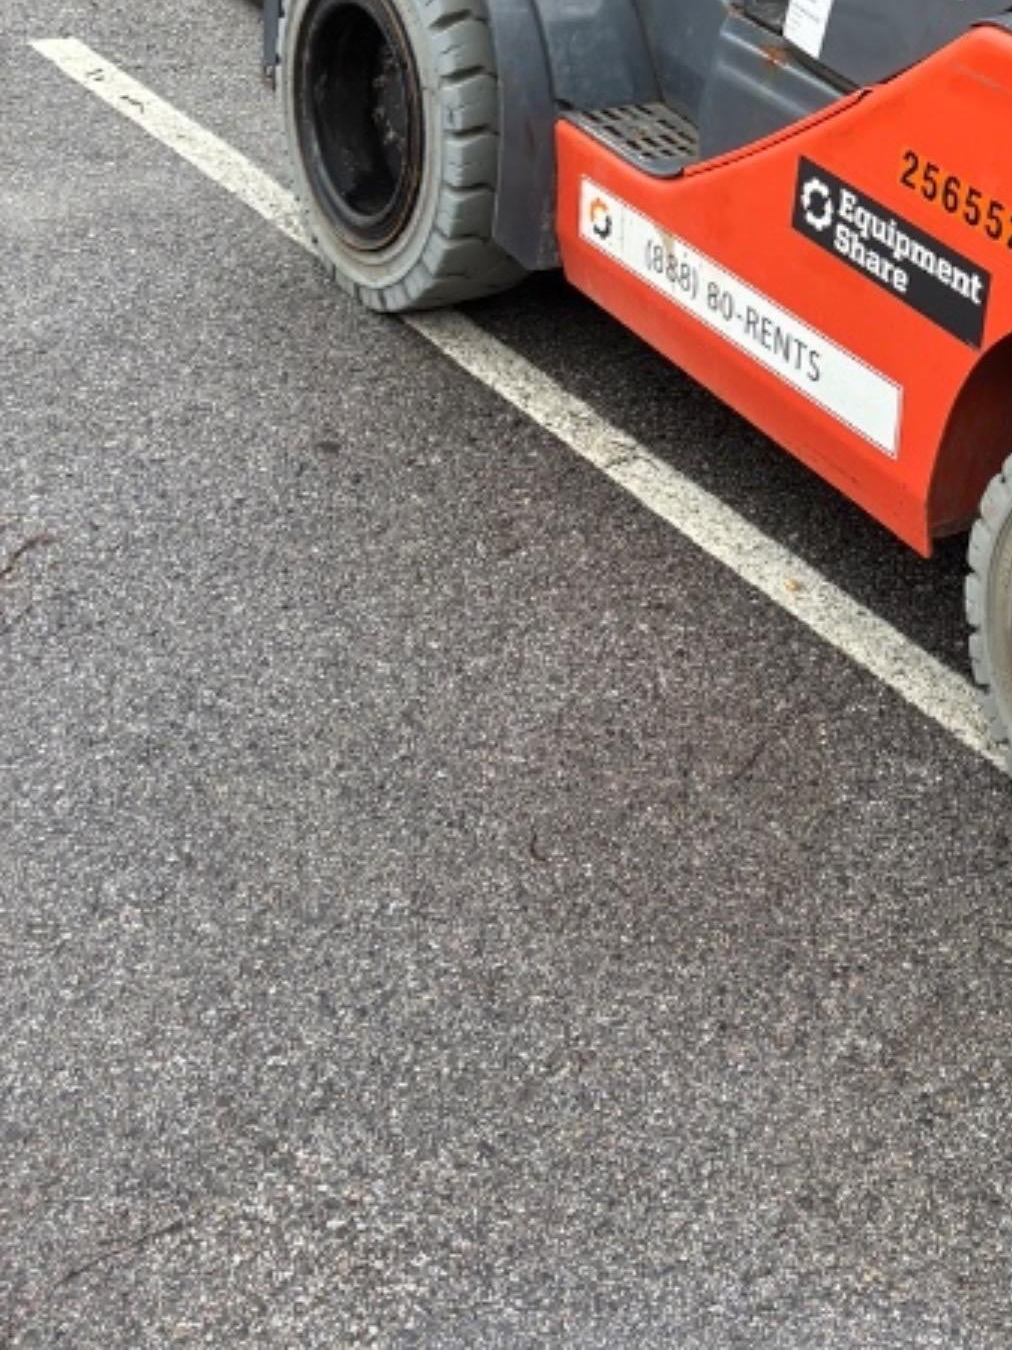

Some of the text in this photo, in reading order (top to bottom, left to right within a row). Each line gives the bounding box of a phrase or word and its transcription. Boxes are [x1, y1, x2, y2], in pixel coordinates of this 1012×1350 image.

[834, 223, 909, 294] Share
[838, 188, 984, 306] Equipment
[644, 237, 821, 383] (888) 80-RENTS
